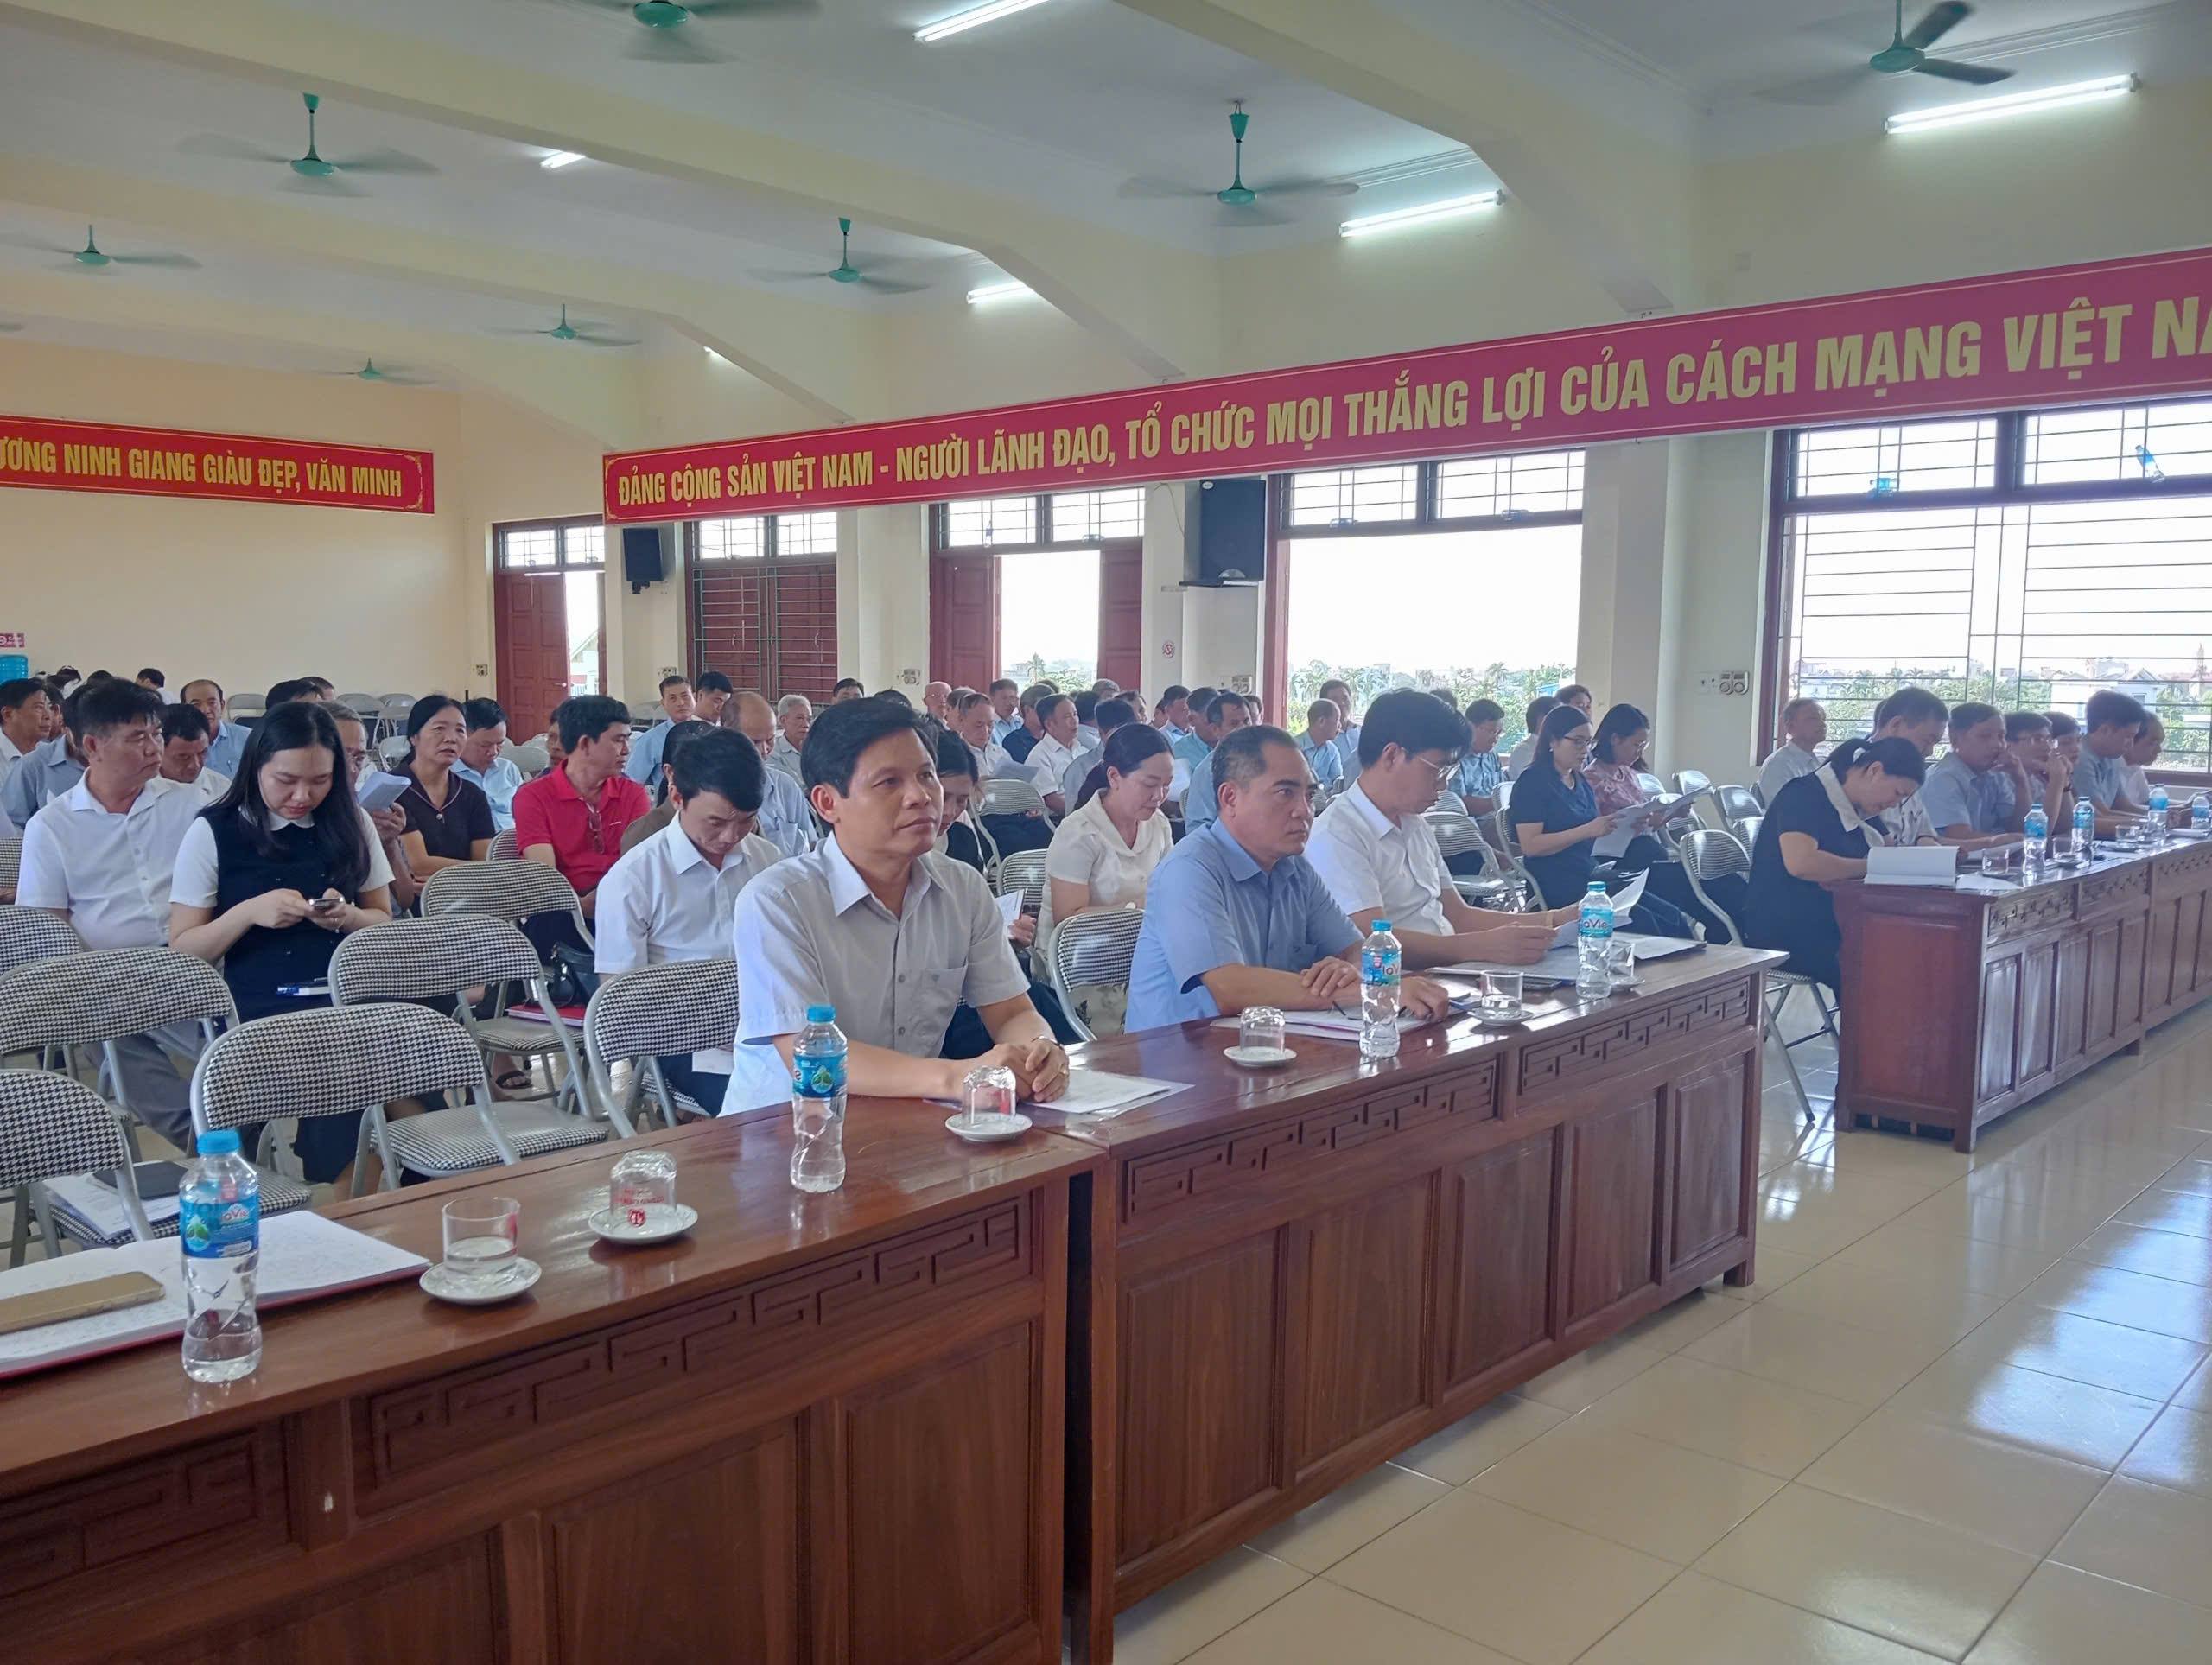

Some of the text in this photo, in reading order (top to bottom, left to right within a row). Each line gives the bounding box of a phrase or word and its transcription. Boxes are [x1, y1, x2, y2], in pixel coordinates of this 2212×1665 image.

[619, 467, 665, 505] ĐẢNG
[671, 464, 721, 507] CỘNG
[728, 454, 766, 497] SẢN
[773, 452, 816, 499] VIỆT
[823, 451, 873, 488] NAM
[897, 435, 969, 481] NGƯỜI
[978, 429, 1044, 474] LÃNH
[1053, 424, 1116, 473] ĐẠO,
[1125, 401, 1161, 460] TỔ
[1171, 401, 1254, 454] CHỨC
[1267, 396, 1331, 451] MỌI
[1344, 370, 1467, 436] THẮNG
[1483, 367, 1545, 432] LỢI
[1561, 346, 1649, 415] CỦA
[1666, 339, 1797, 404] CÁCH
[1815, 321, 1981, 397] MẠNG
[2002, 297, 2133, 380] VIỆT
[2152, 296, 2212, 359] N
[64, 444, 121, 476] NINH
[129, 449, 195, 481] GIANG
[203, 449, 251, 485] GIÀU
[258, 459, 300, 495] ĐẸP,
[307, 458, 345, 493] VĂN
[352, 467, 402, 497] MINH
[1581, 918, 1607, 929] aVie
[221, 1209, 250, 1221] aVie
